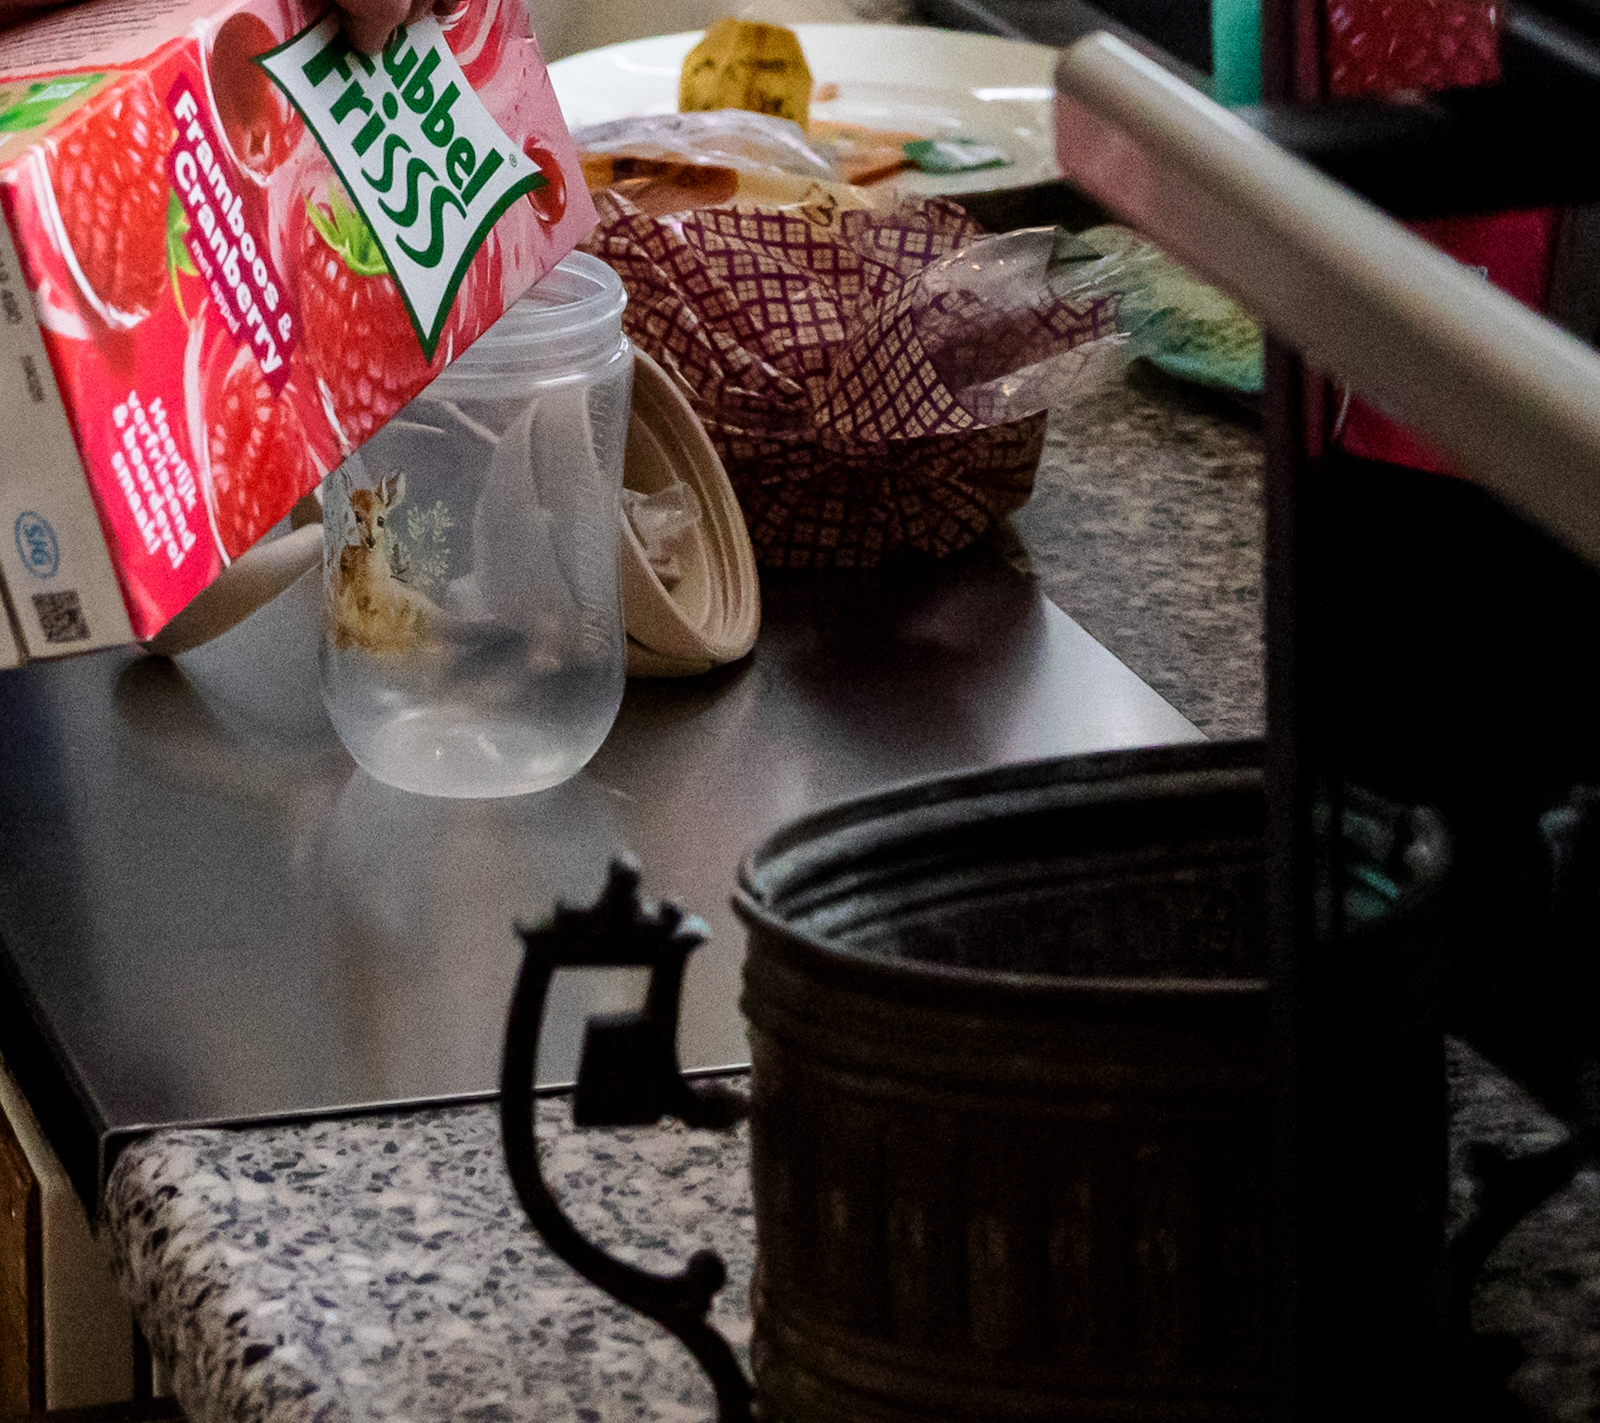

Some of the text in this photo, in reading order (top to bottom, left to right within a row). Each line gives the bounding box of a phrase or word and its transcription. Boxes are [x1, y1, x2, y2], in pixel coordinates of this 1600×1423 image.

[381, 21, 506, 208] ubbel
[173, 89, 293, 342] Framboos &
[174, 150, 284, 374] Cranberry
[111, 451, 163, 555] smaak!
[113, 403, 186, 569] & boordevol
[128, 389, 197, 551] verfrissend
[149, 396, 197, 513] Heerlijk
